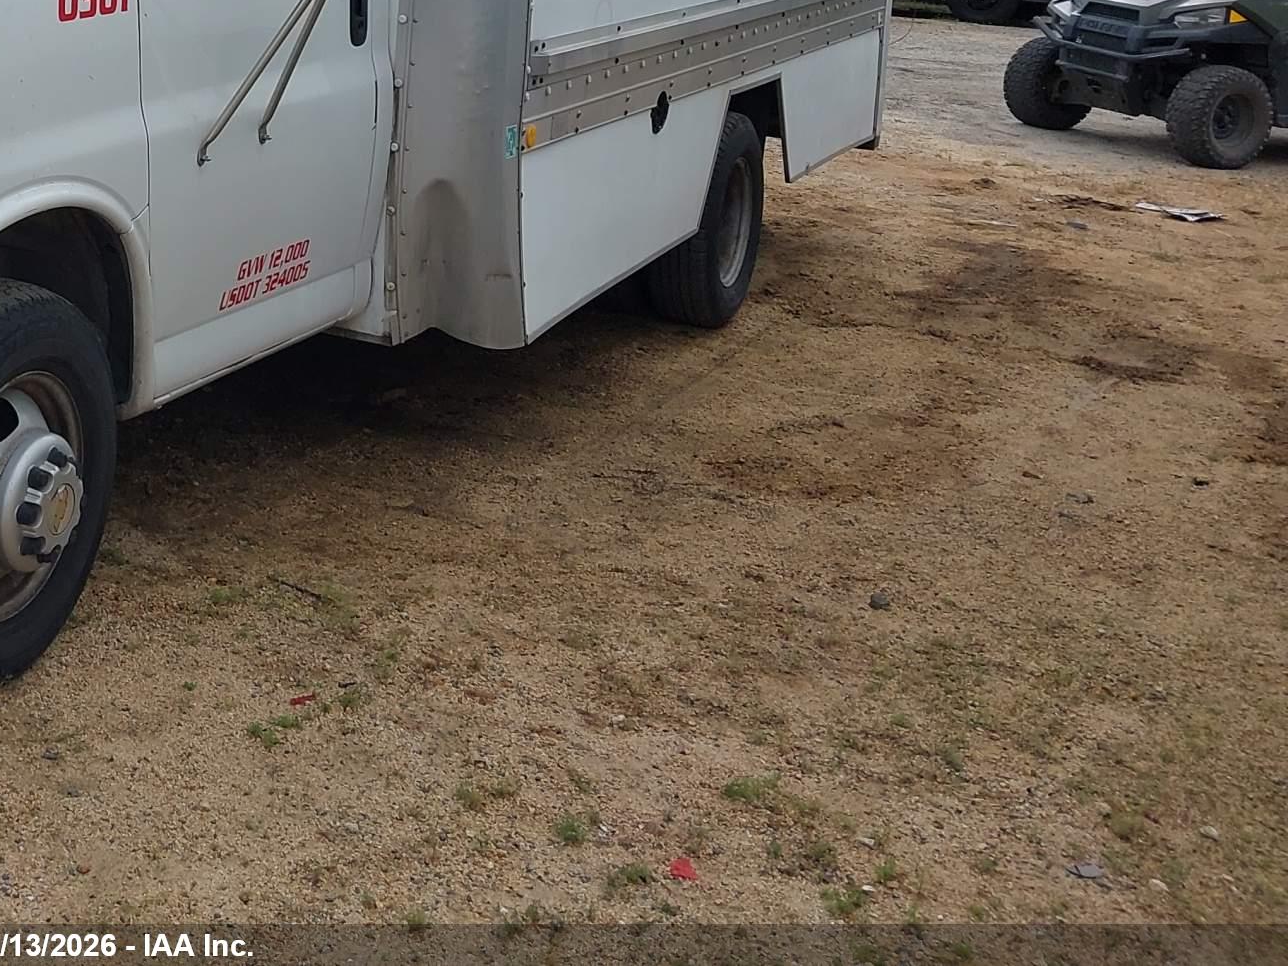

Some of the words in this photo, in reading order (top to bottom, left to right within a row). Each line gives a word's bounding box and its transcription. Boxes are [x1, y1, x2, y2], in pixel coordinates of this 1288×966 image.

[268, 239, 310, 270] 12,000
[219, 279, 262, 311] USDOT
[262, 260, 311, 294] 324005
